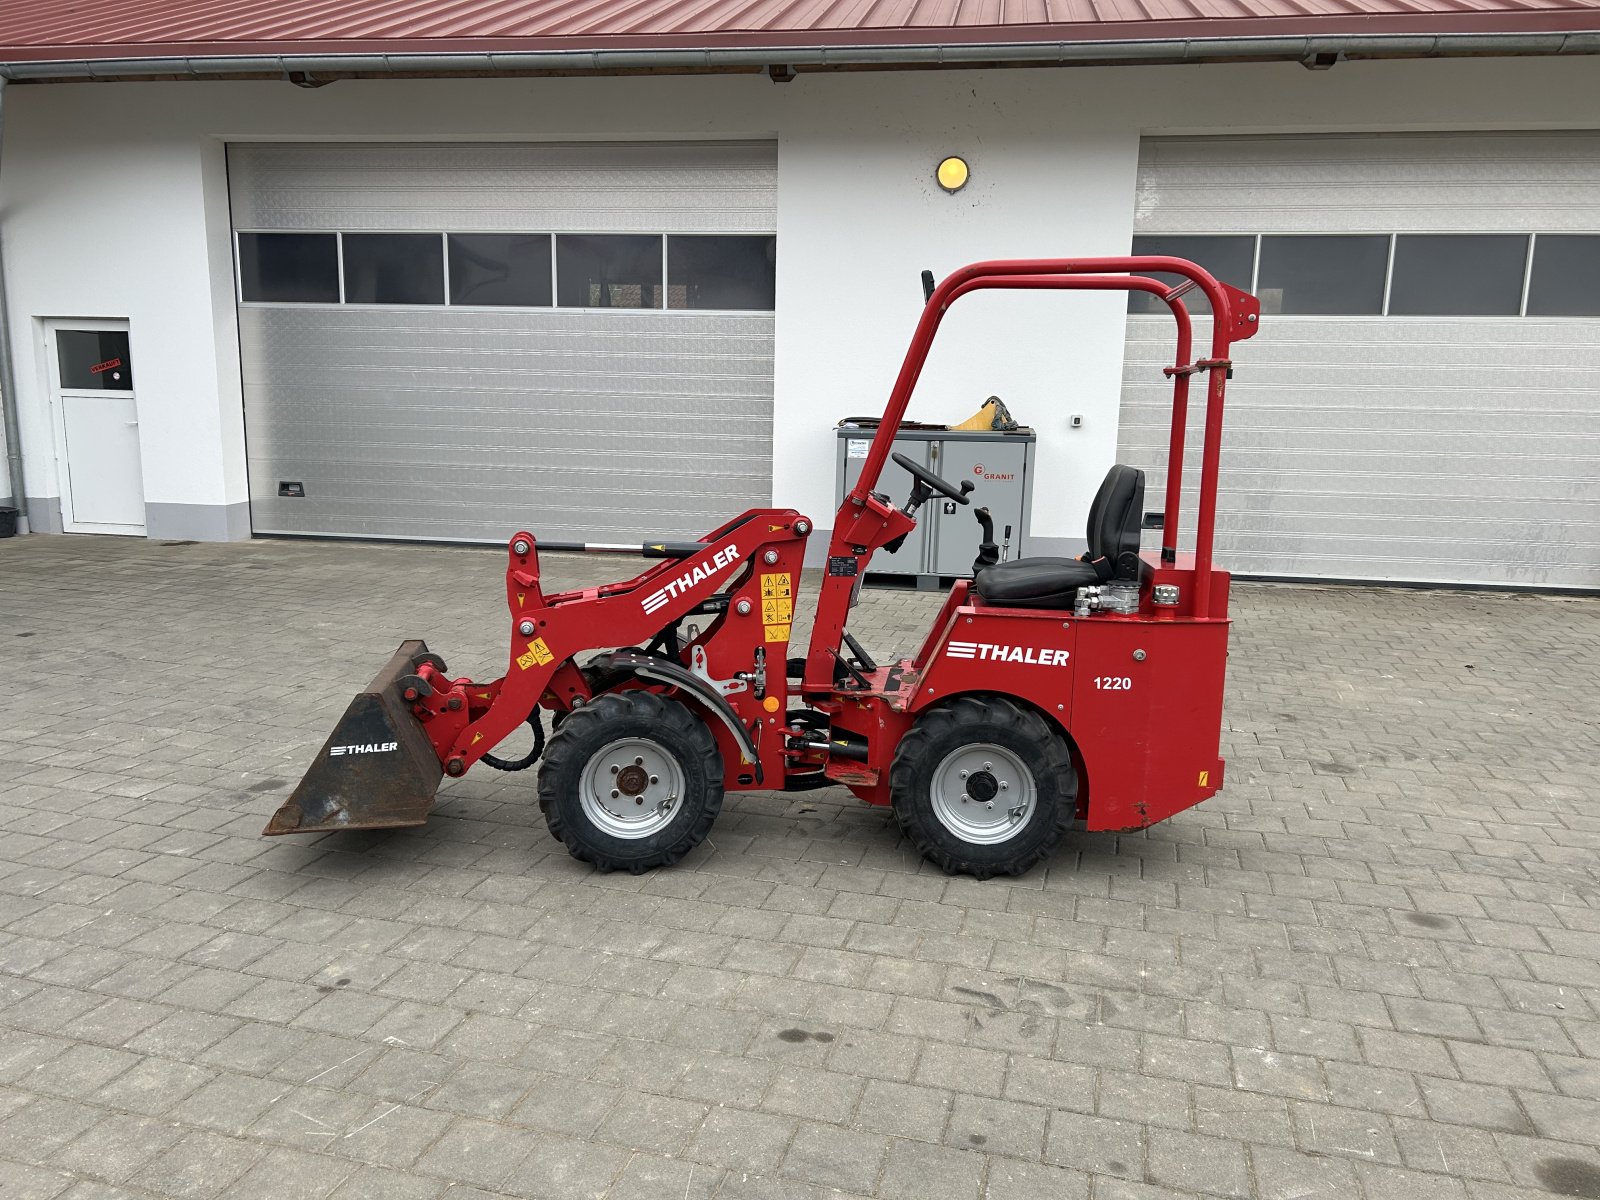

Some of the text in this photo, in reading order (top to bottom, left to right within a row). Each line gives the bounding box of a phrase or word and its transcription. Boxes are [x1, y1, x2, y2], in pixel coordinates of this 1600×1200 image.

[91, 360, 120, 372] VERKAUFT
[664, 544, 740, 598] THALER
[978, 643, 1070, 666] THALER
[1093, 676, 1132, 690] 1220
[347, 742, 398, 755] THALER
